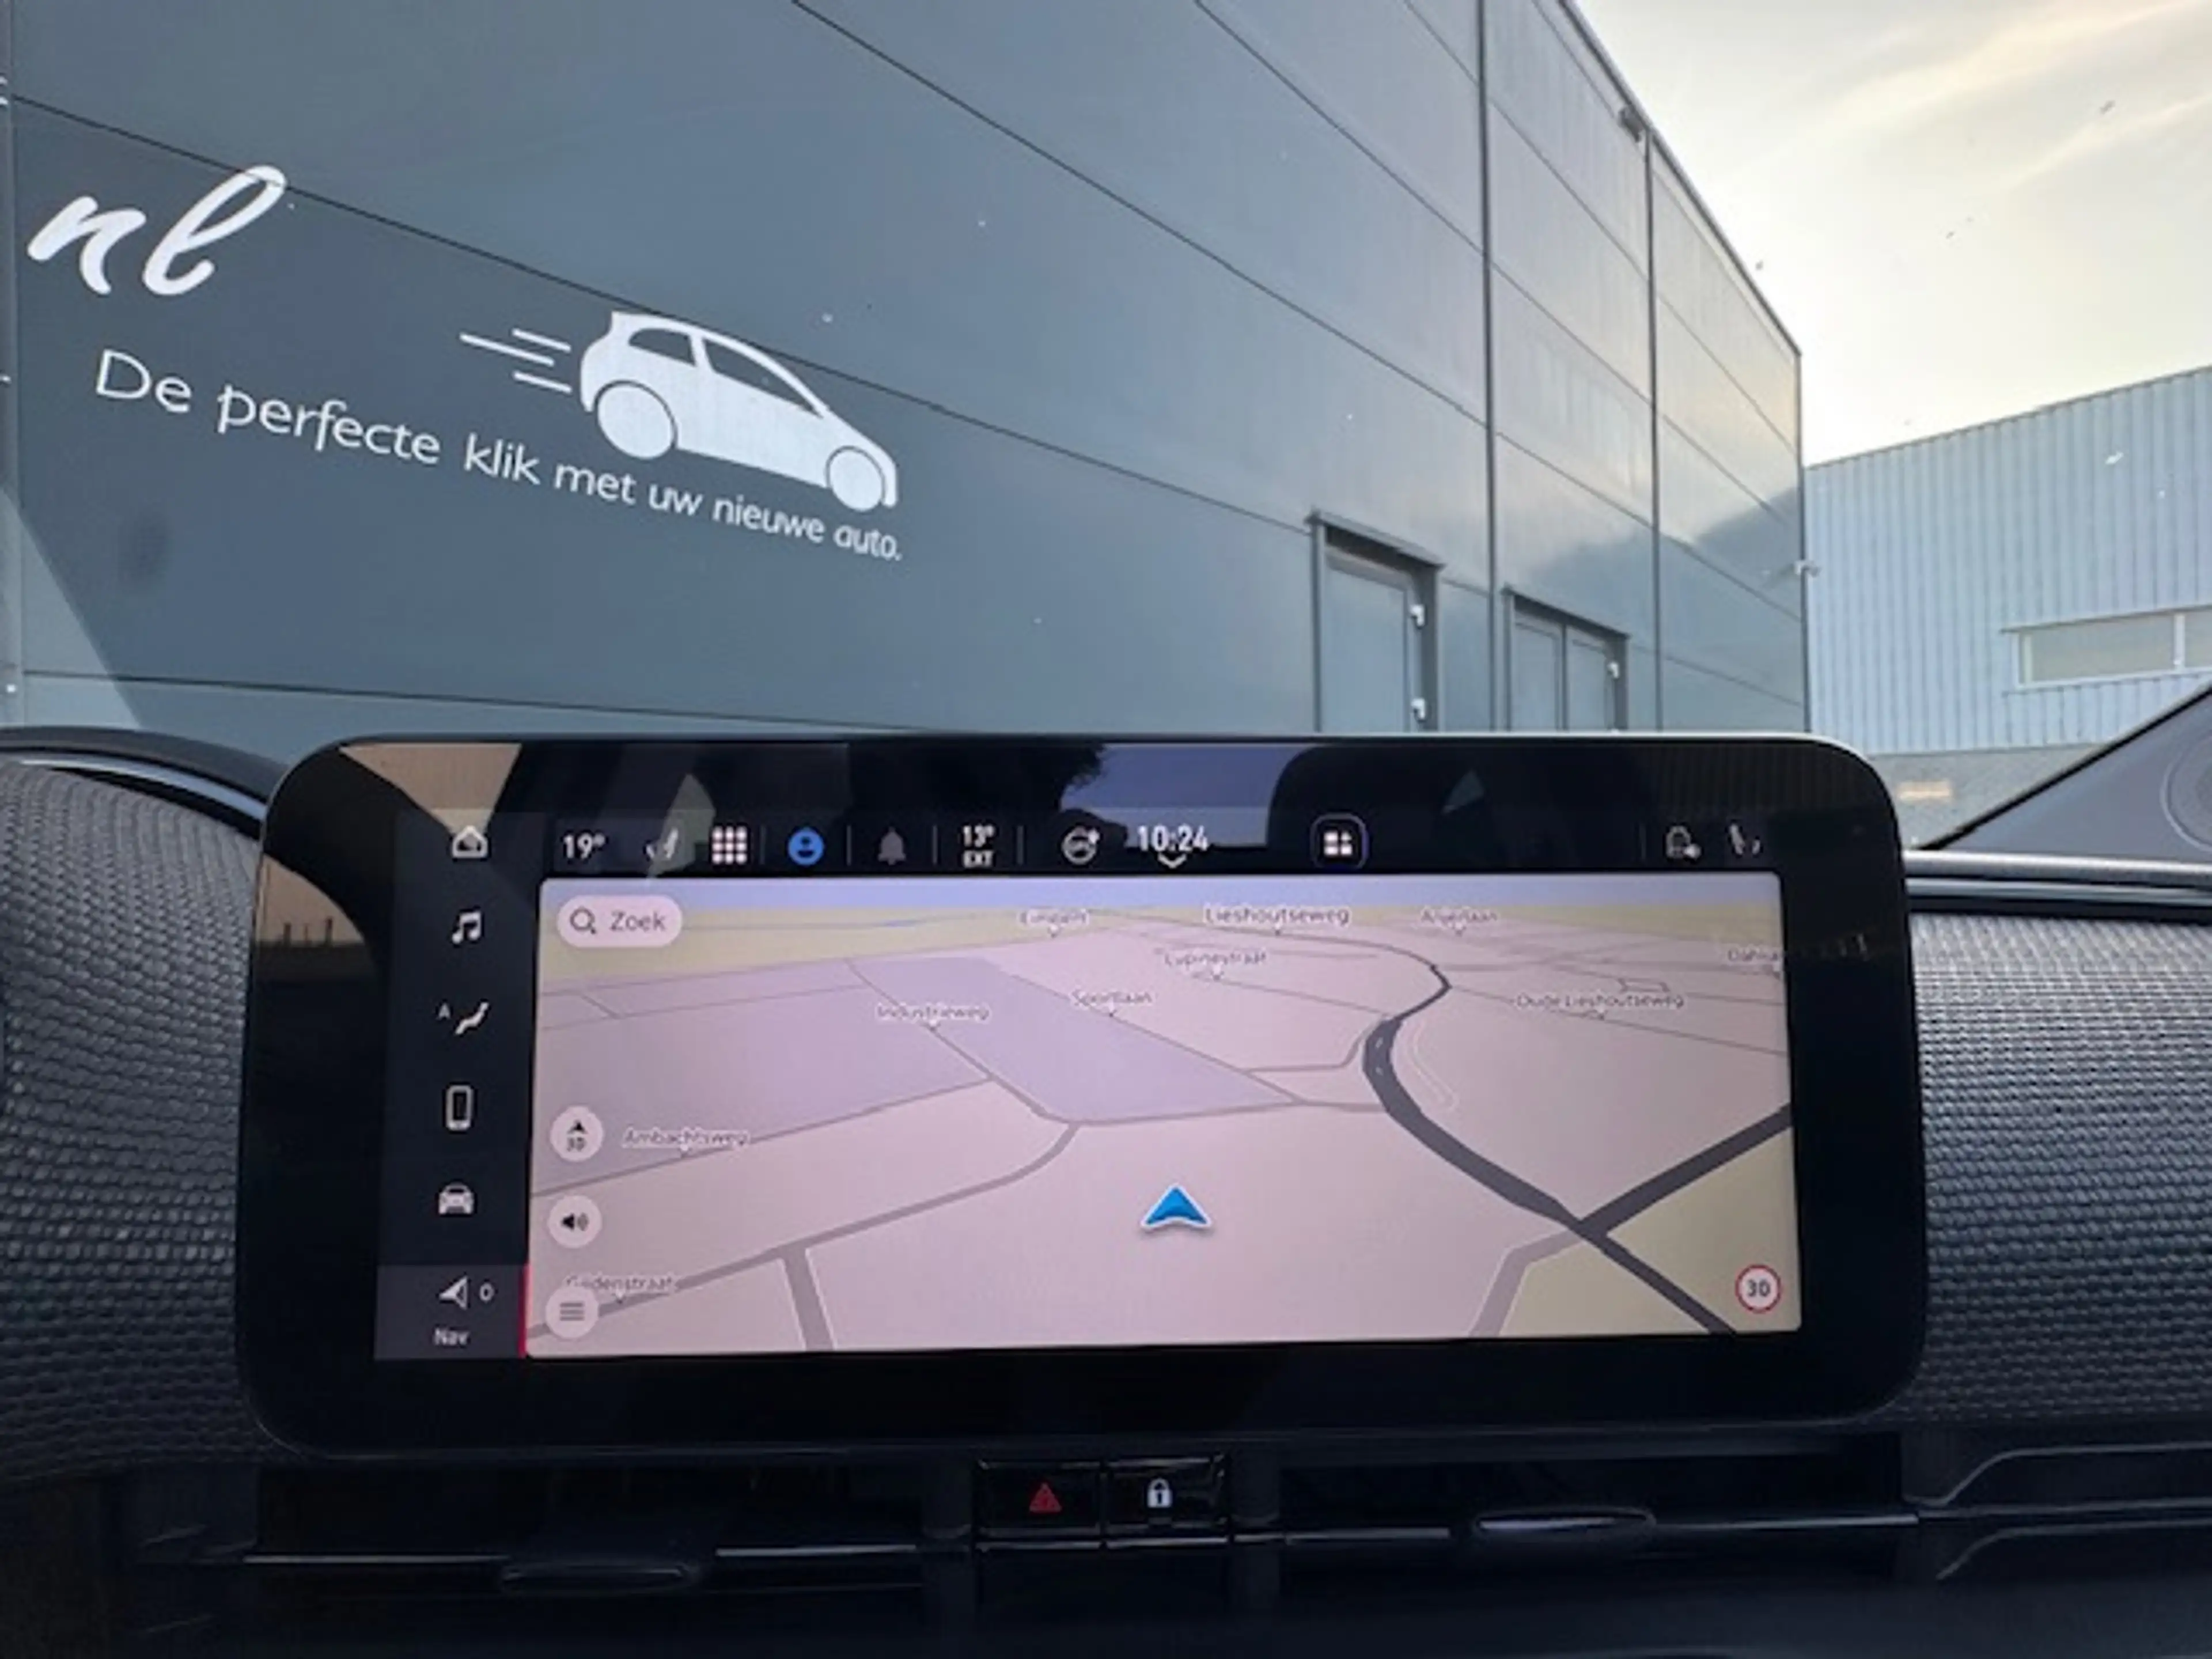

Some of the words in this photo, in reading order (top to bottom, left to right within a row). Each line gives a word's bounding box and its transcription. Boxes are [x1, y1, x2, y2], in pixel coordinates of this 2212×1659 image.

[27, 165, 287, 296] nl
[95, 349, 192, 414] De
[217, 384, 441, 464] perfecte
[463, 433, 541, 486] klik
[554, 462, 636, 505] met
[648, 484, 703, 516] uw
[713, 495, 825, 543] nieuwe
[833, 523, 903, 561] auto.
[1137, 825, 1209, 852] 10:24
[608, 910, 667, 933] Zoek
[1745, 1279, 1772, 1298] 30
[434, 1328, 468, 1346] Nav
